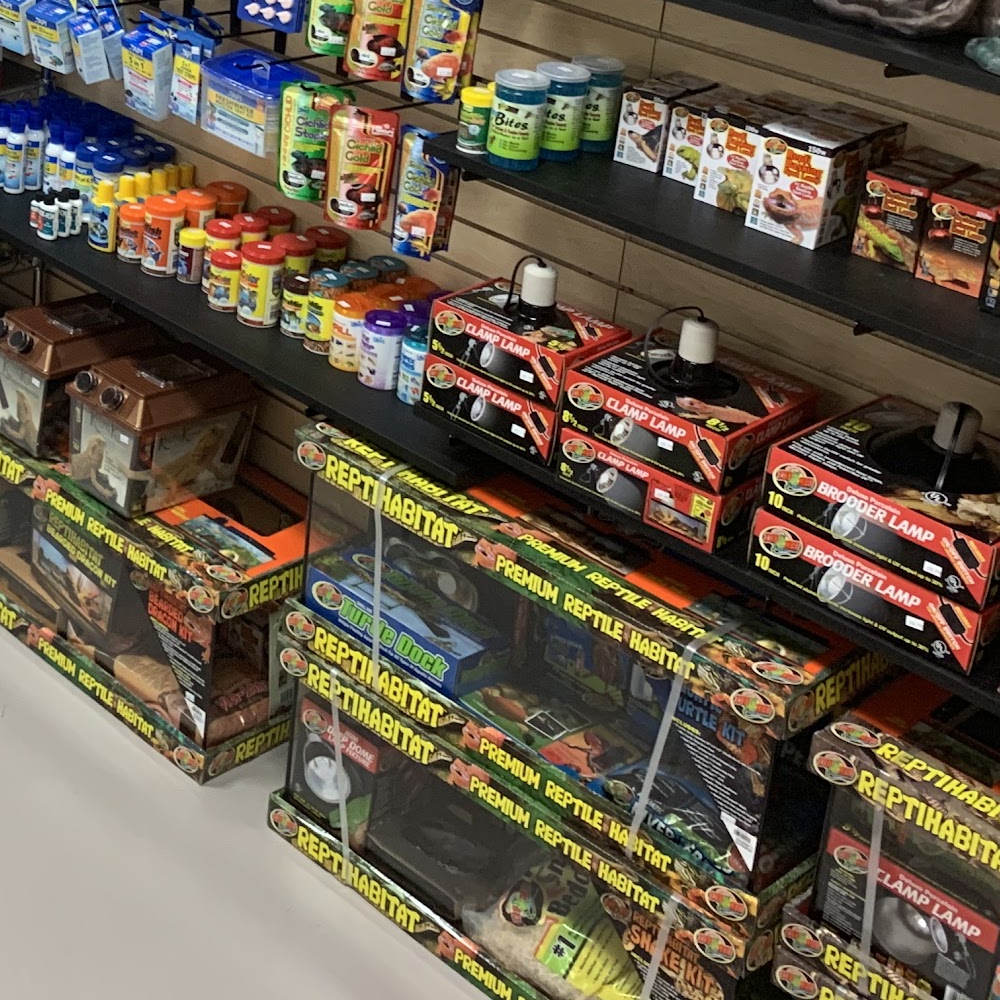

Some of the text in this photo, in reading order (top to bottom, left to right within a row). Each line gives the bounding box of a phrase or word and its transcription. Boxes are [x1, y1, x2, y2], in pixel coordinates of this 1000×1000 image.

[368, 1, 392, 13] Gold
[216, 94, 254, 113] FRESHWATER
[494, 113, 528, 132] Bites
[345, 151, 370, 162] Gold
[347, 140, 382, 153] Cichlid
[465, 323, 531, 358] CLAMP LAMP
[456, 376, 522, 413] CLAMP LAMP
[606, 397, 686, 438] CLAMP LAMP
[597, 451, 649, 480] CLAMP LAMP
[326, 455, 459, 548] REPTIHABITAT
[768, 491, 782, 509] 10
[817, 481, 935, 543] BROODER LAMP
[846, 486, 901, 516] Deluxe Porcelain
[45, 489, 168, 581] PREMIUM REPTILE HABITAT
[147, 524, 193, 553] HABITAT
[518, 533, 589, 573] PREMIUM
[586, 571, 653, 610] REPTILE
[755, 553, 769, 570] 10
[803, 545, 921, 609] BROODER LAMP
[832, 550, 887, 580] Deluxe Porcelain
[104, 573, 117, 588] KIT
[495, 555, 695, 680] PREMIUM REPTILE HABITAT
[396, 634, 448, 679] Dock
[38, 637, 155, 738] PREMIUM REPTILE HABITAT
[314, 627, 444, 727] REPTIHABITAT
[307, 664, 434, 765] REPTIHABITAT
[678, 699, 717, 732] URTLE
[722, 724, 746, 746] KIT
[349, 741, 374, 763] DOME
[480, 738, 540, 789] PREMIUM
[546, 780, 603, 831] REPTILE
[470, 776, 530, 828] PREMIUM
[535, 820, 592, 871] REPTILE
[598, 860, 660, 913] HABITAT
[298, 826, 420, 933] REPTIHABITAT
[931, 903, 981, 938] LAMP
[553, 935, 576, 958] #1
[454, 949, 512, 1000] PREMIUM
[684, 962, 713, 991] KIT
